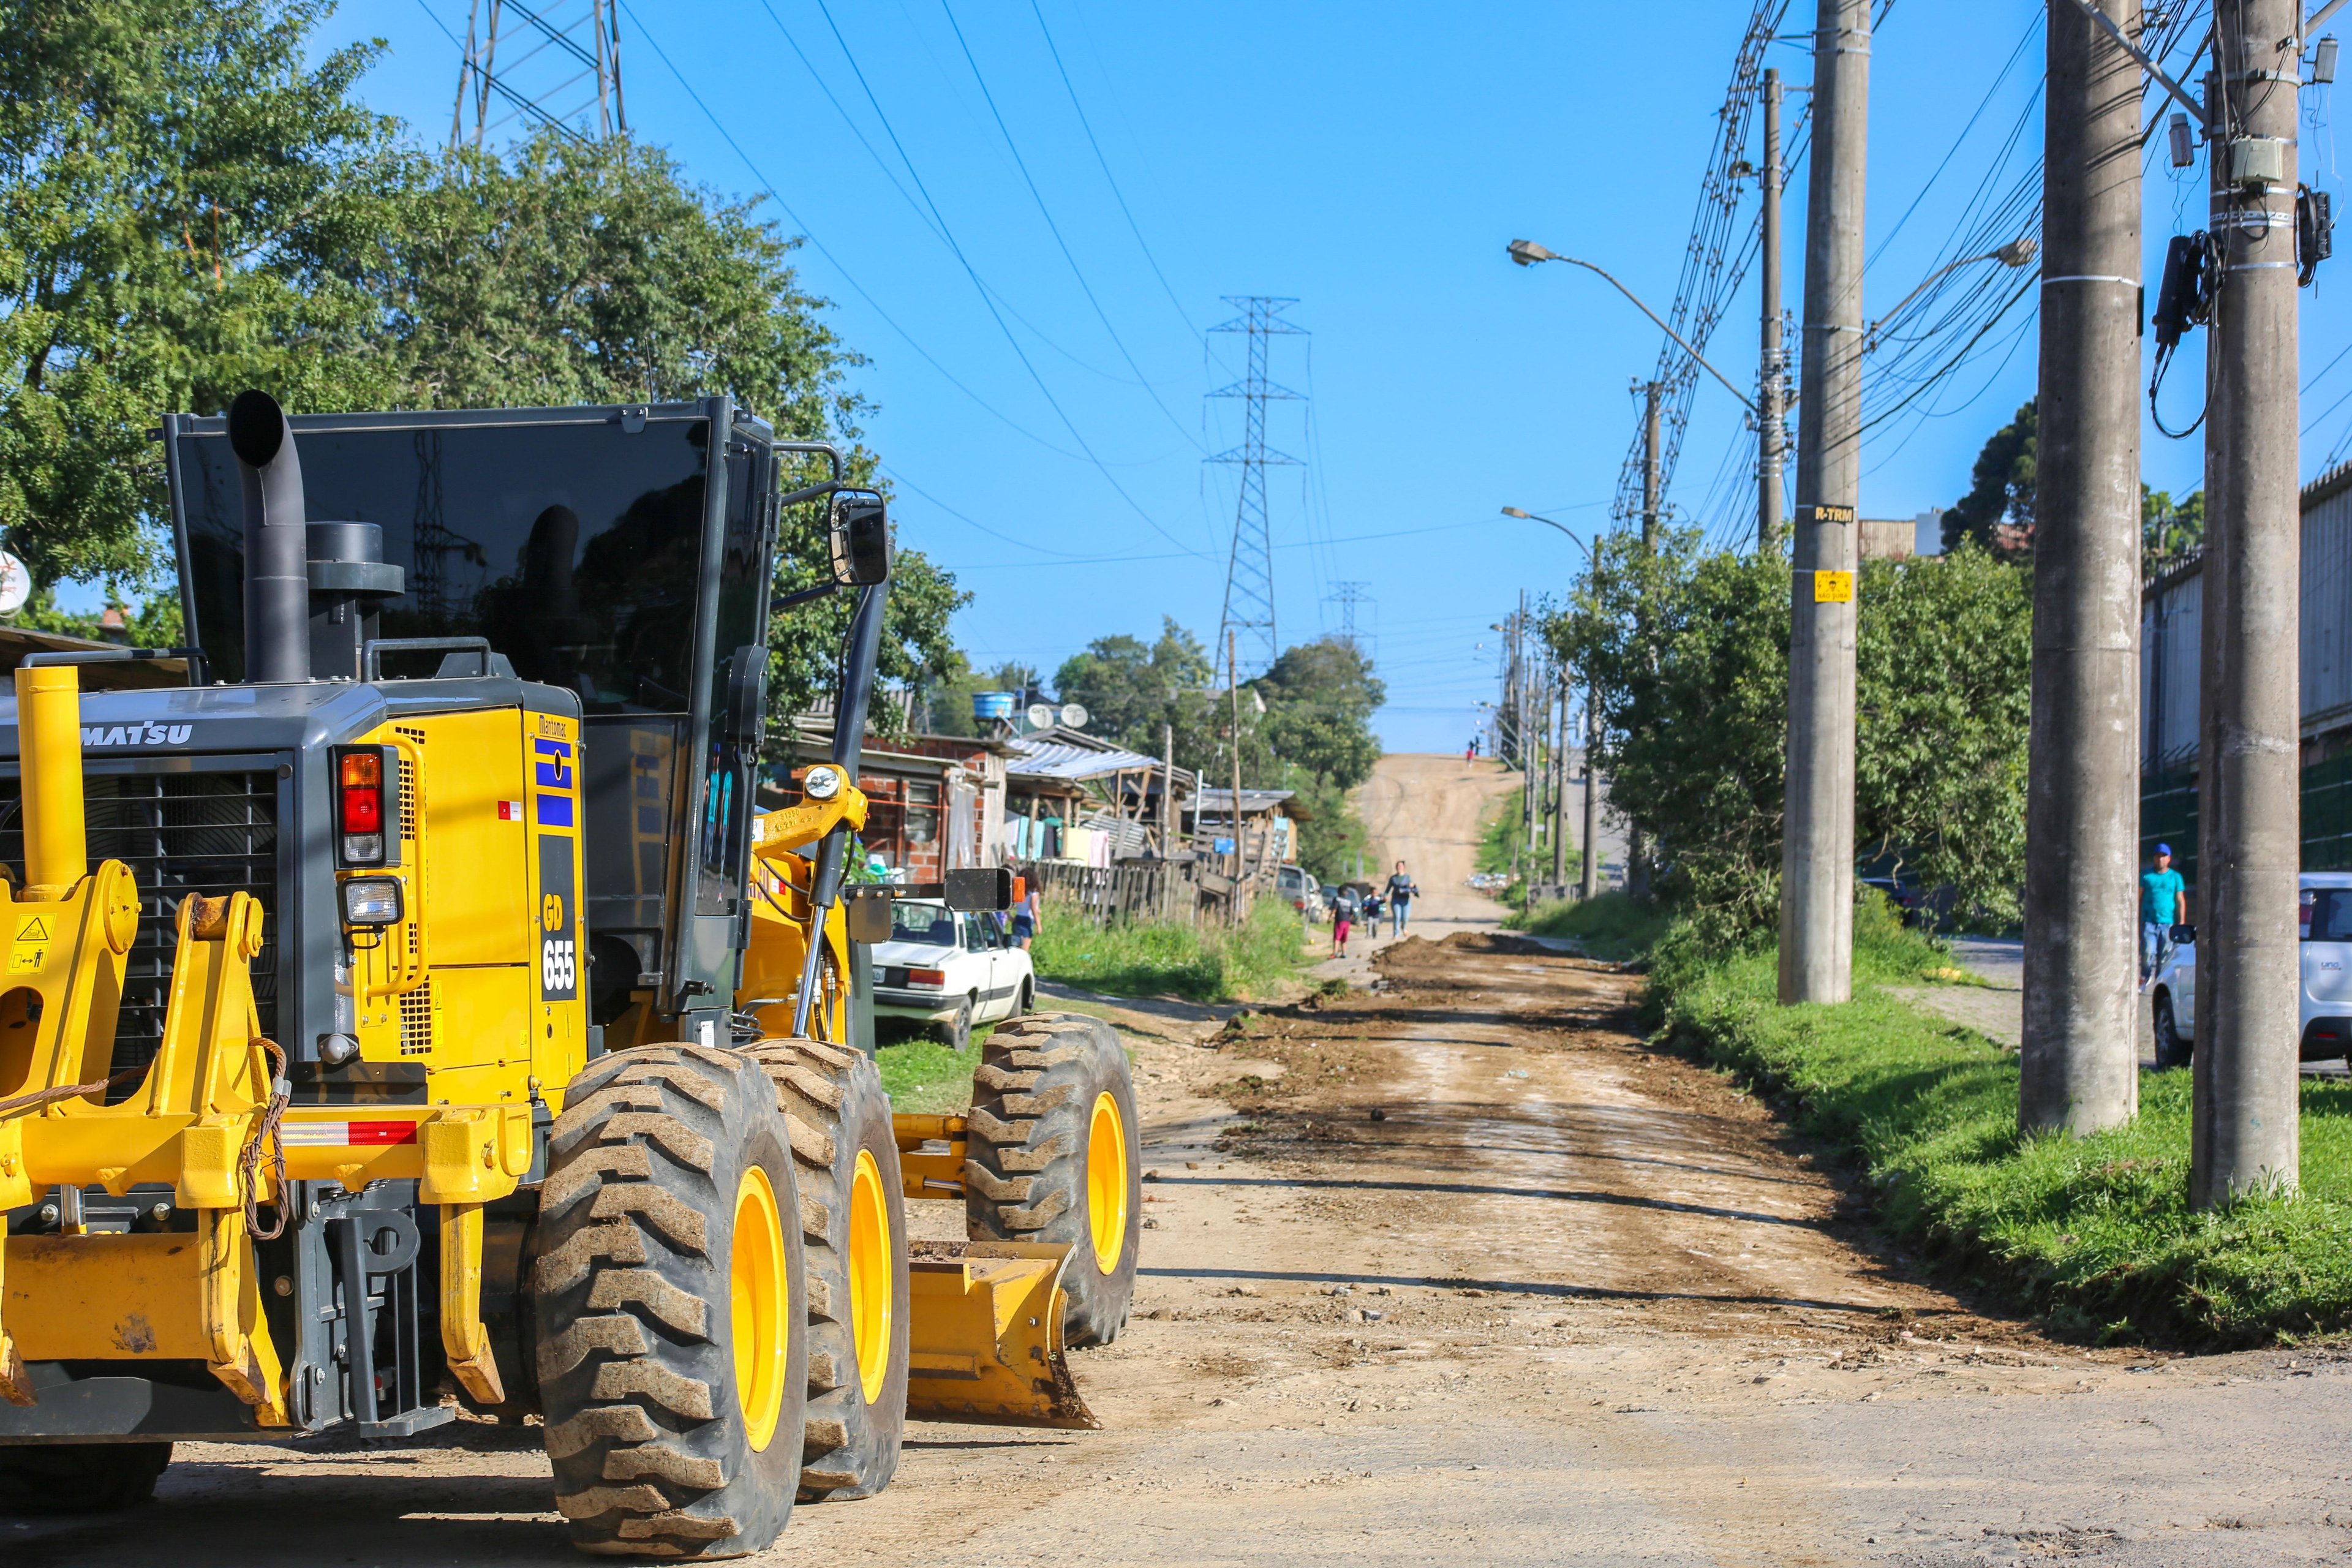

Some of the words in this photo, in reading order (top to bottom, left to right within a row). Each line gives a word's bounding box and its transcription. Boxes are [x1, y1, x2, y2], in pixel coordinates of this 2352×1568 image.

[539, 714, 566, 737] Mantomac
[543, 892, 564, 933] GD
[543, 939, 575, 992] 655
